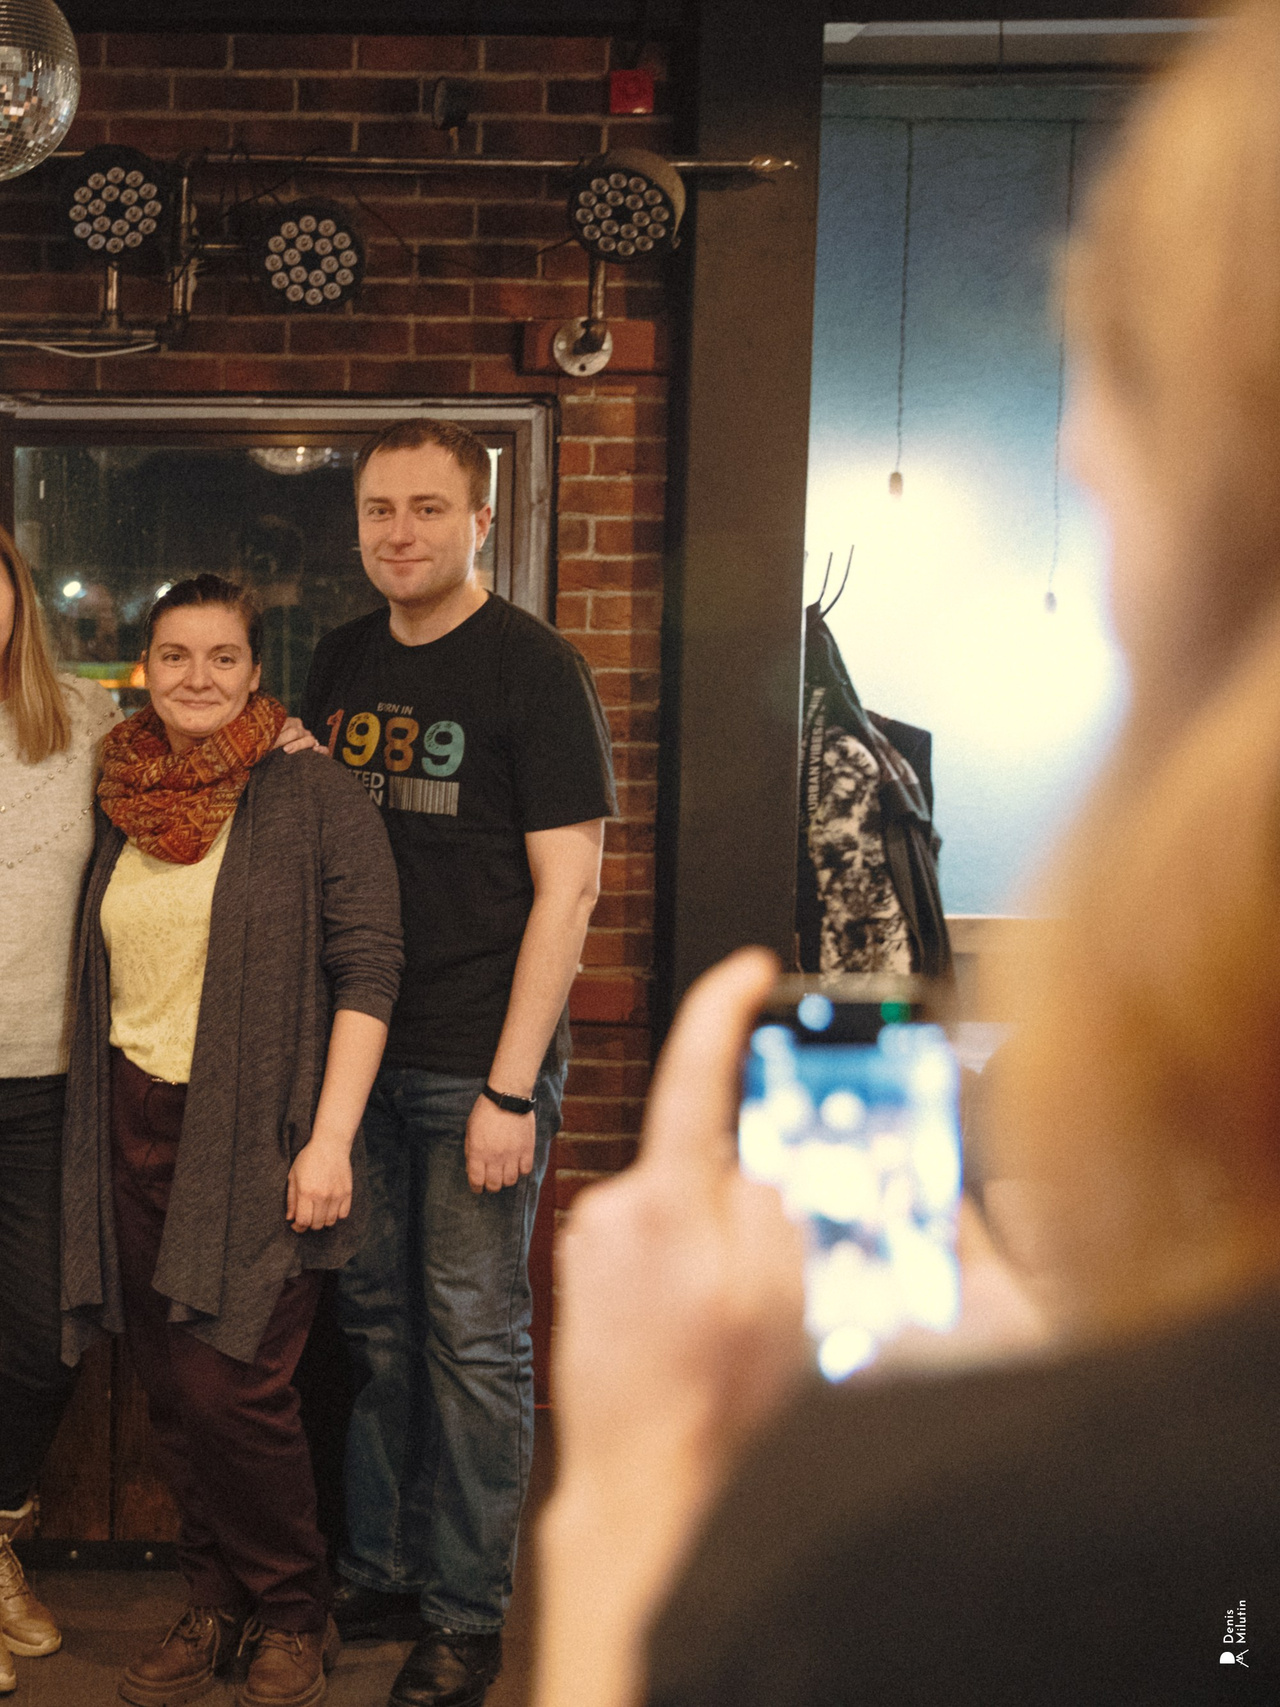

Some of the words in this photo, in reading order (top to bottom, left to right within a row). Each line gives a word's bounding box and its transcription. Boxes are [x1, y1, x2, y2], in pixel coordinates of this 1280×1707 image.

[377, 702, 400, 713] BORN
[401, 705, 413, 715] IN
[326, 708, 465, 777] 1989
[350, 769, 385, 789] TED
[808, 766, 820, 811] URBAN
